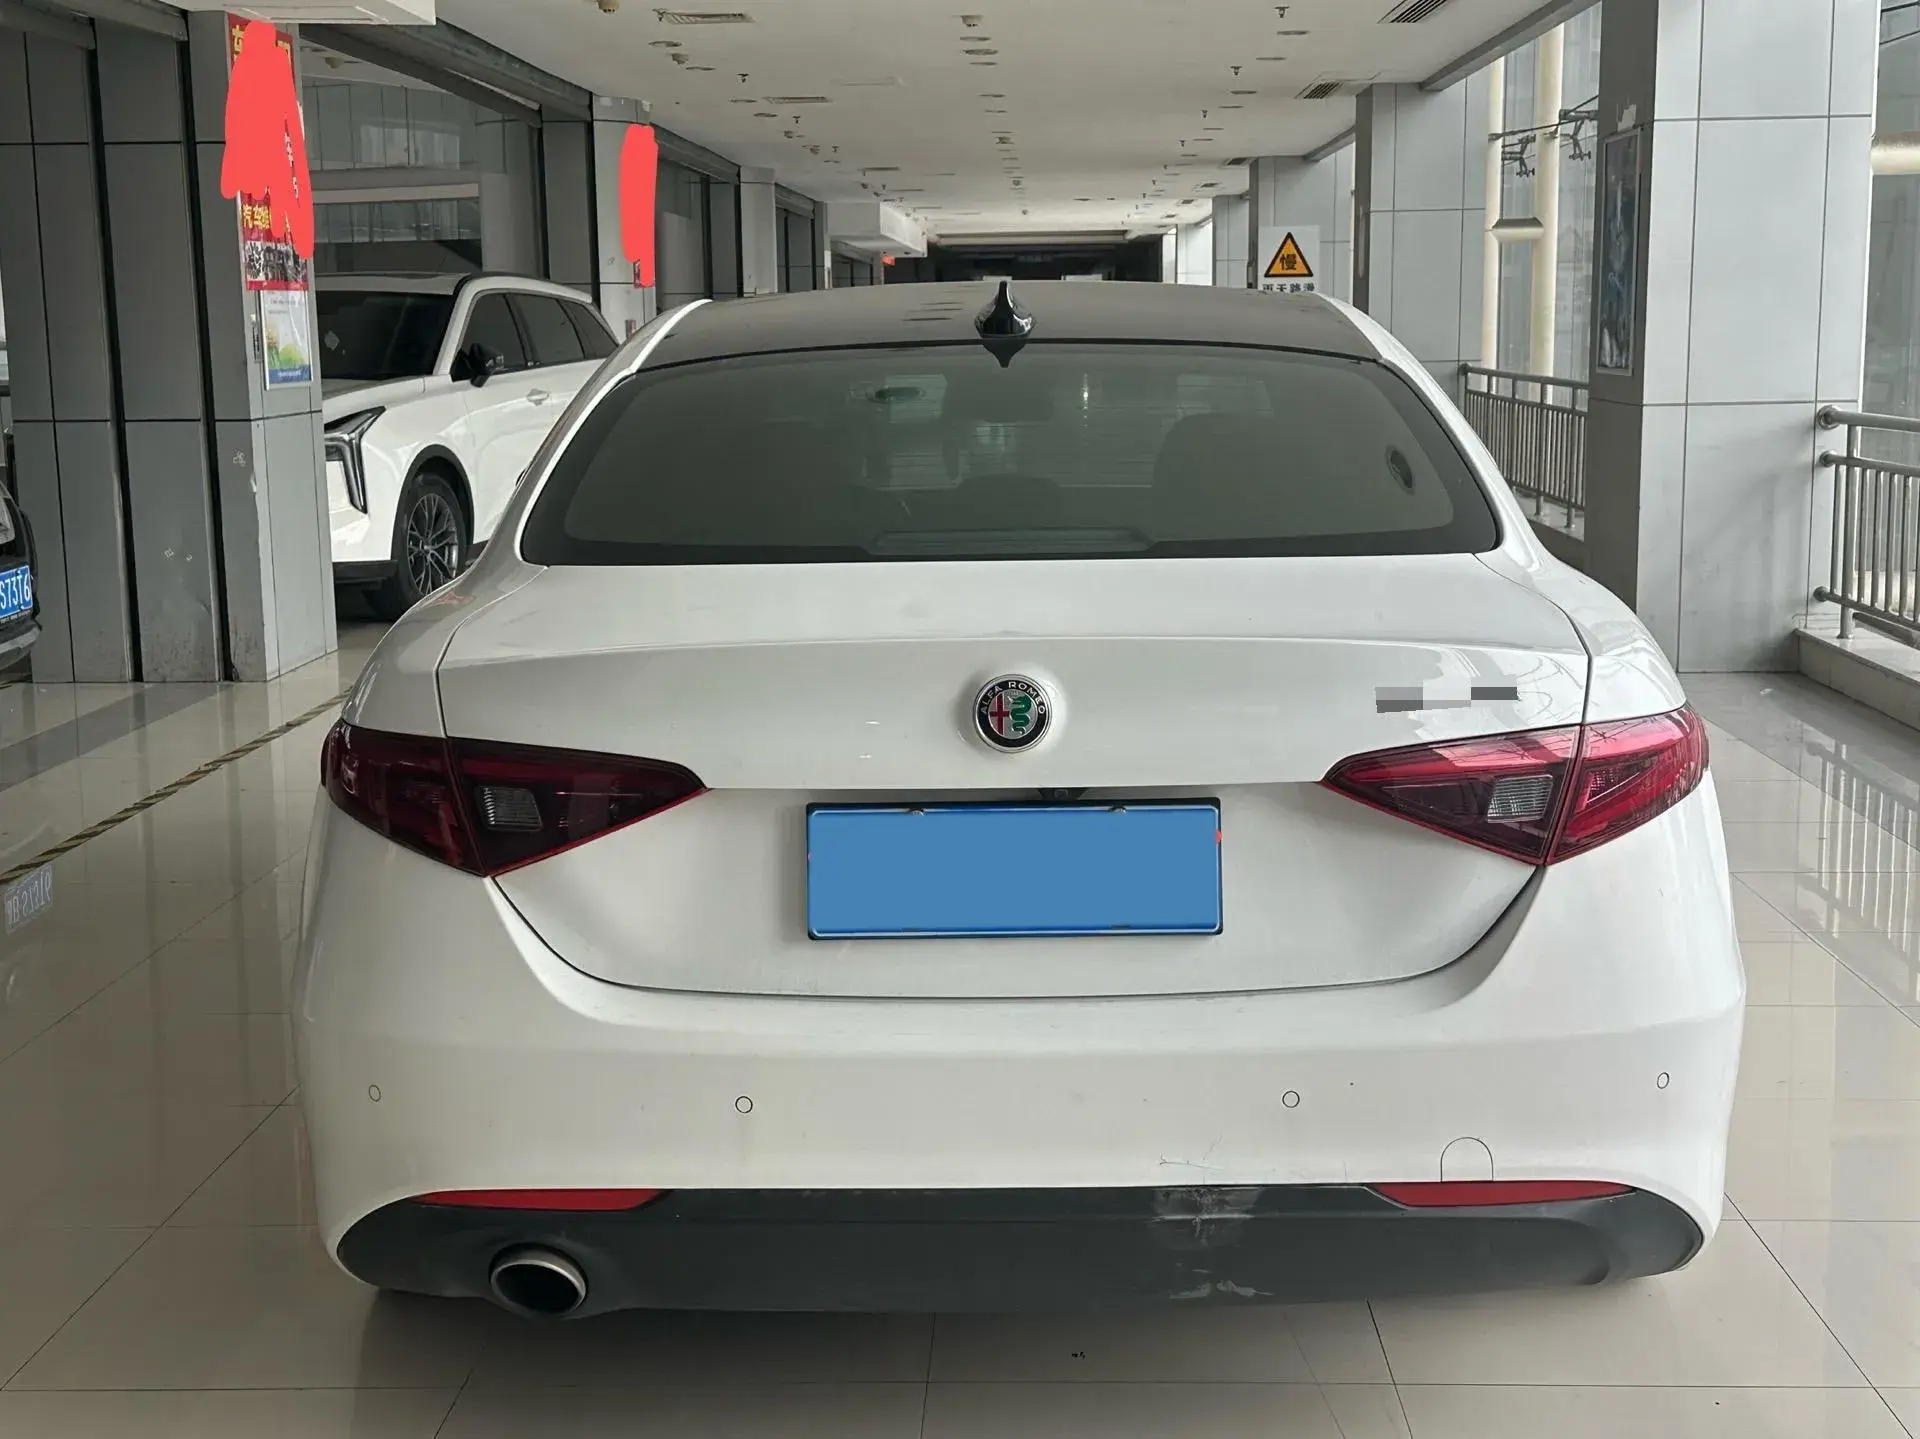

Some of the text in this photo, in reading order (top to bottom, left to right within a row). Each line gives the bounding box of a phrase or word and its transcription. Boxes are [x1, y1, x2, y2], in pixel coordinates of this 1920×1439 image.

[1280, 253, 1297, 271] 慢
[980, 681, 1046, 715] ALFA ROMEO
